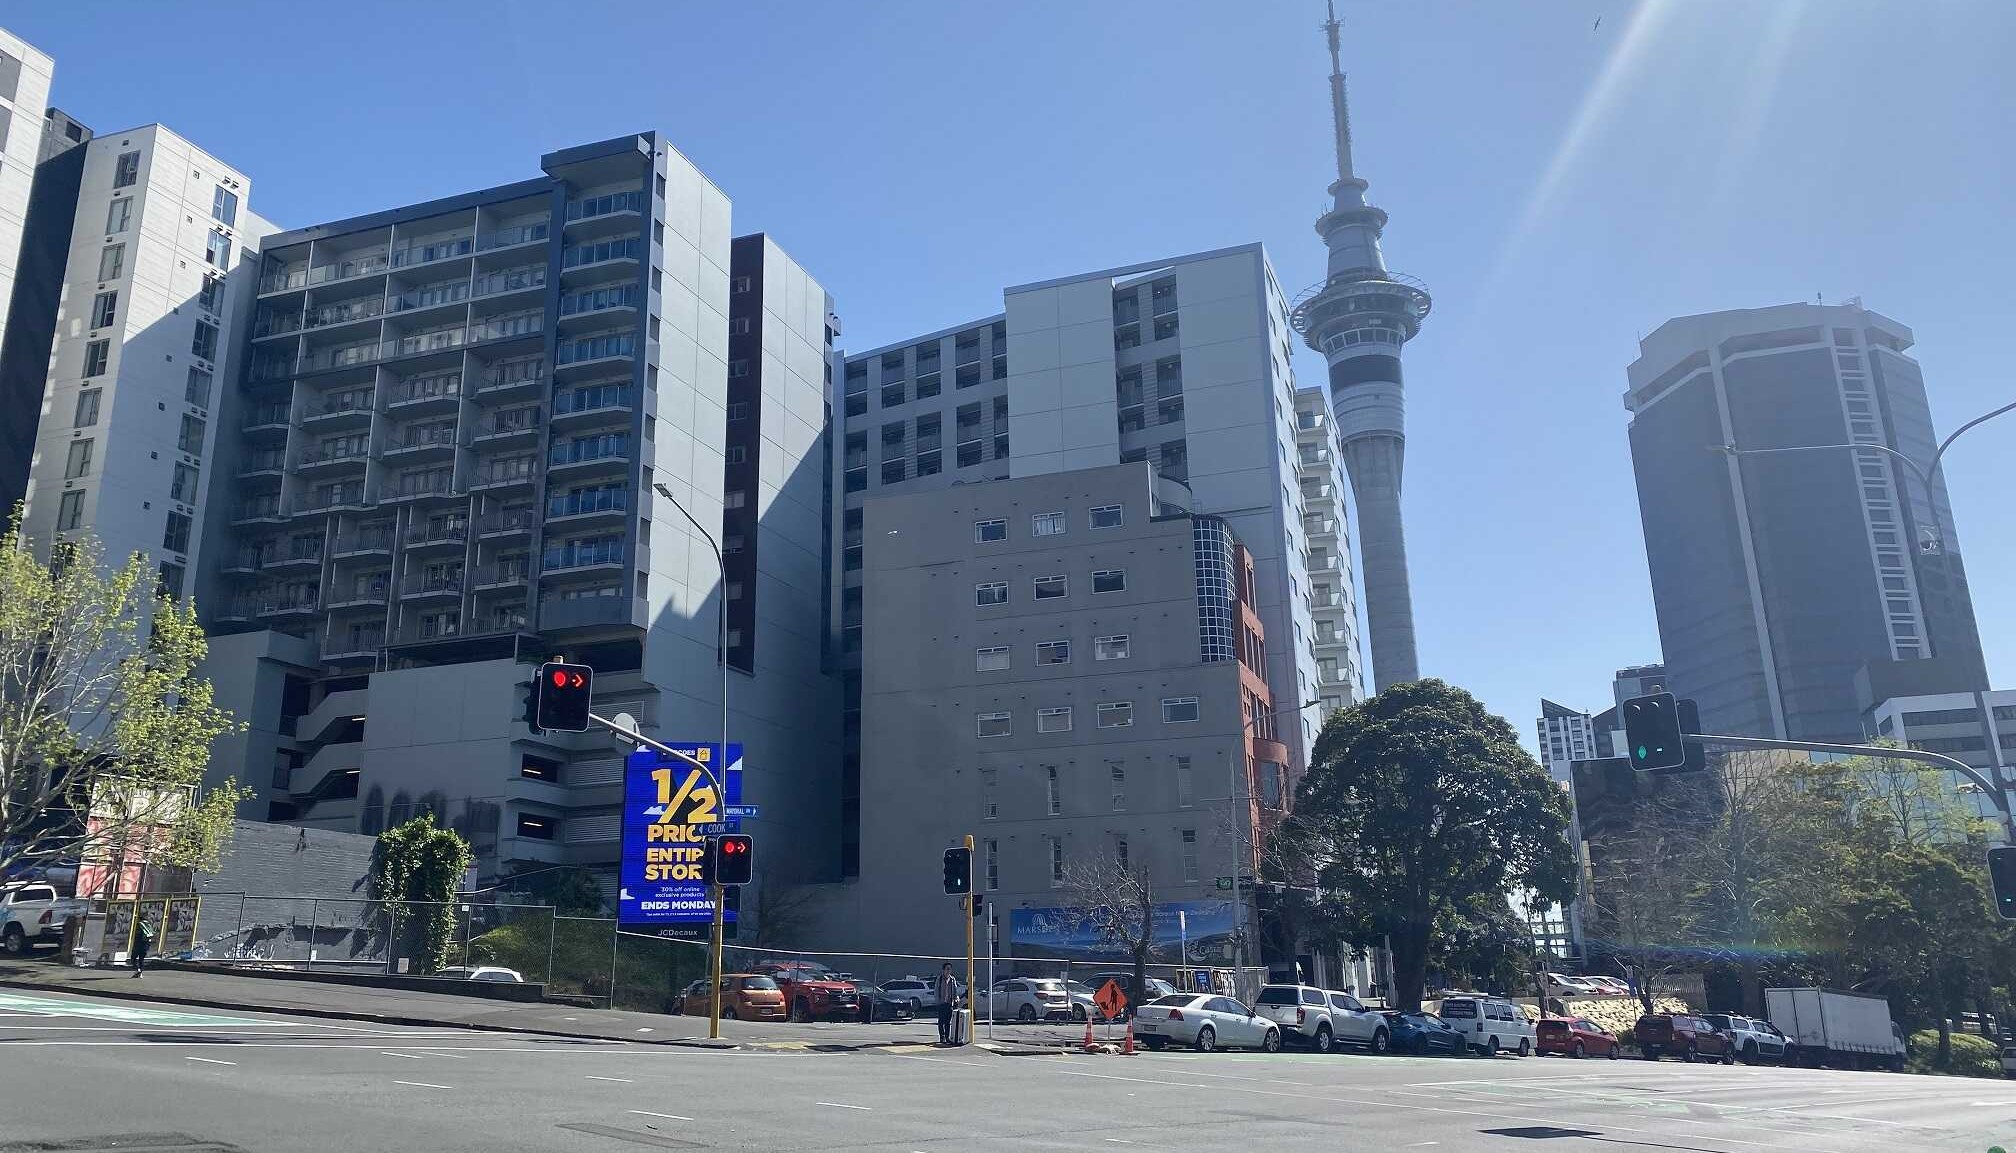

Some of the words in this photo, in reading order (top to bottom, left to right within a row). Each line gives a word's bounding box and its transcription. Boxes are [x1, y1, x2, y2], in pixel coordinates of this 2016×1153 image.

[651, 768, 718, 824] 1/2
[647, 824, 704, 843] PRIC
[707, 823, 726, 833] COOK
[645, 863, 704, 881] STOR
[641, 901, 670, 910] ENDS
[671, 900, 716, 910] MONDAY
